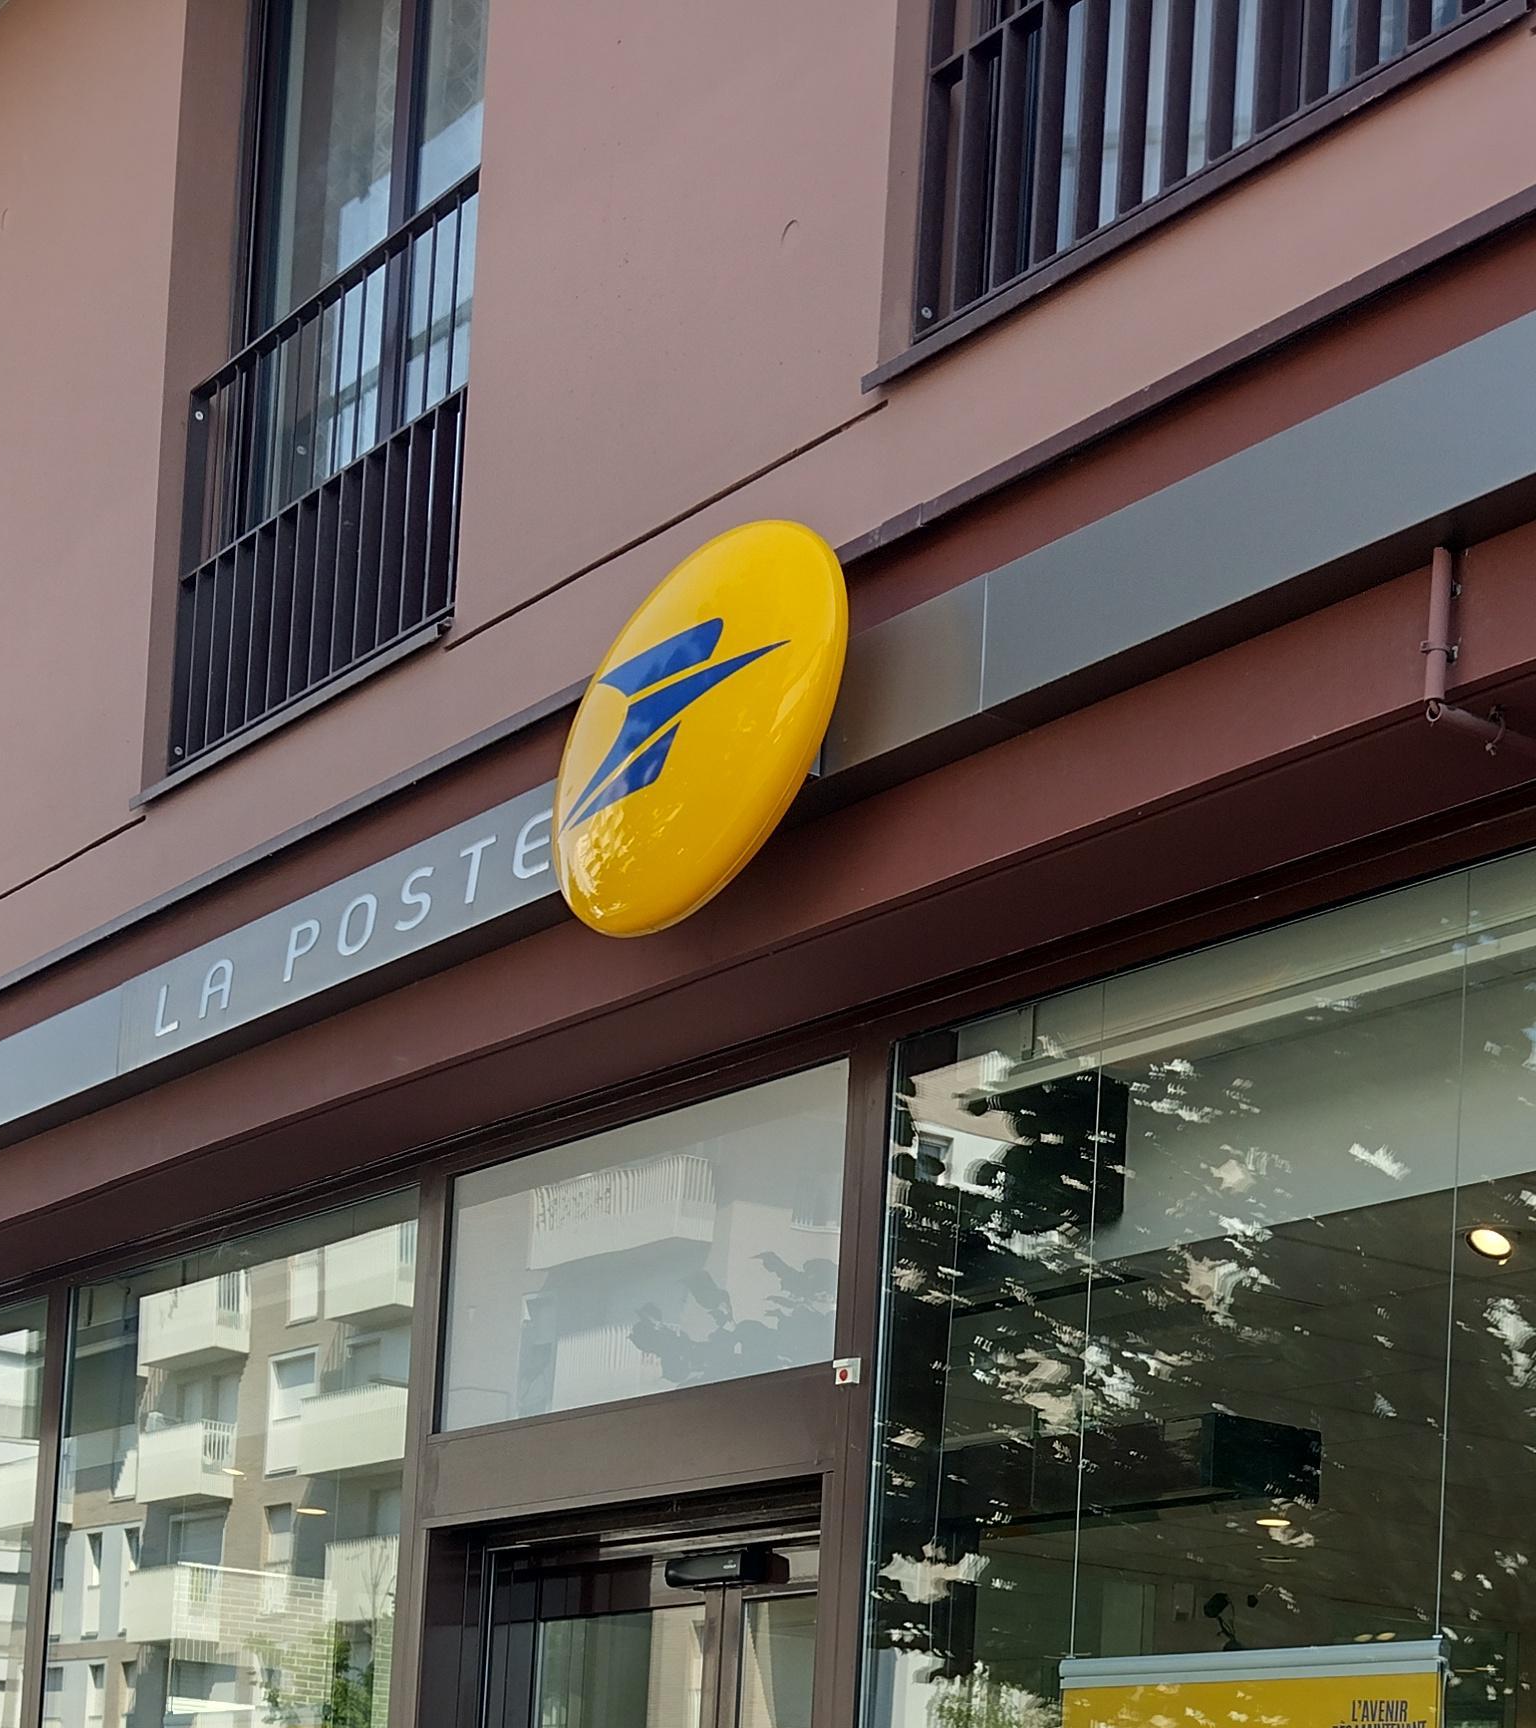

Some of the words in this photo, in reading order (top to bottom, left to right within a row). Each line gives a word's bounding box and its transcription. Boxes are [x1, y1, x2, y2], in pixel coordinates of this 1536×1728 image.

[154, 958, 235, 1038] LA
[282, 808, 553, 983] POSTE
[1351, 1699, 1408, 1722] L'AVENIR
